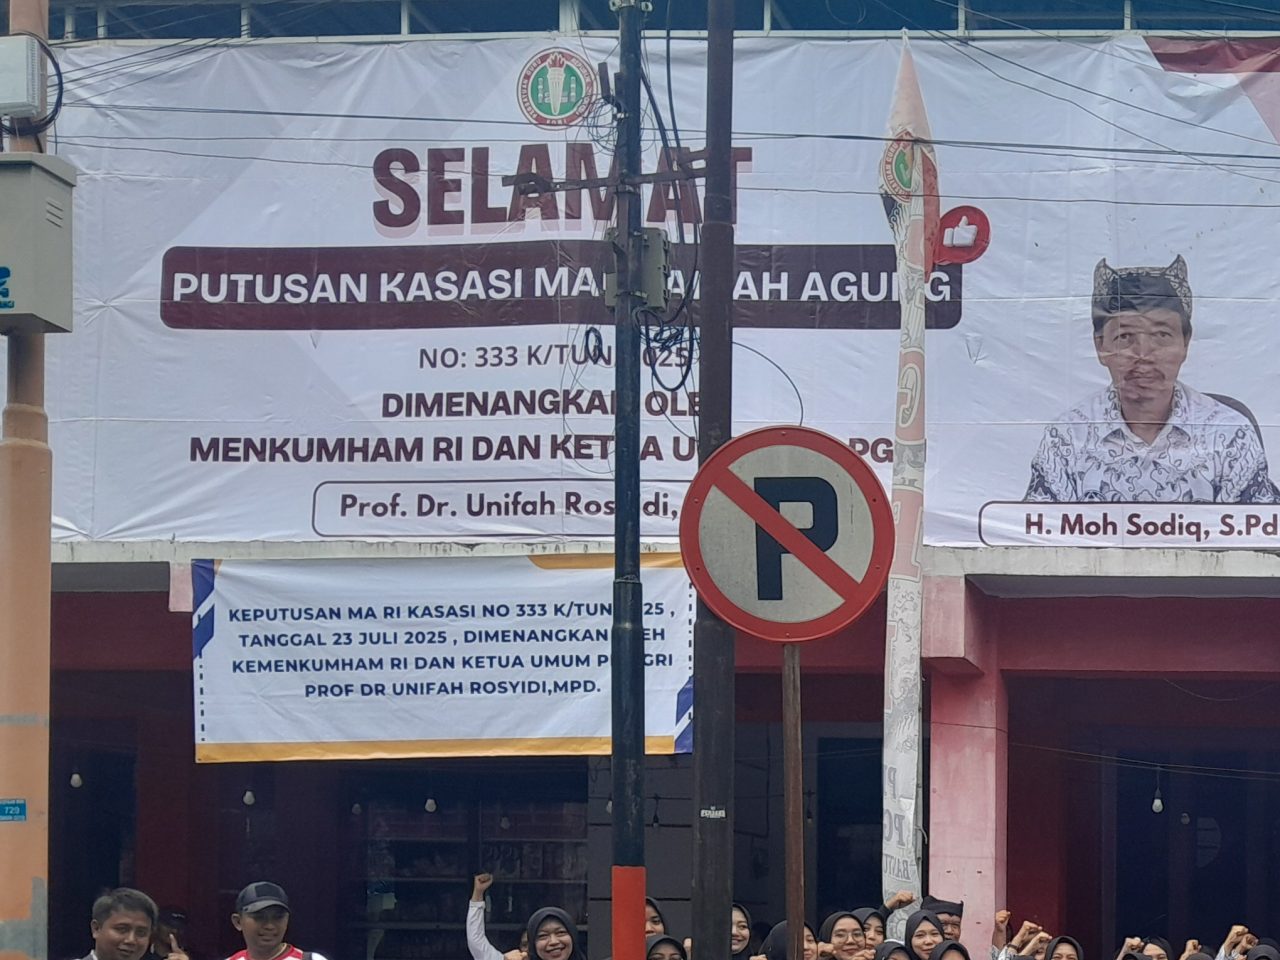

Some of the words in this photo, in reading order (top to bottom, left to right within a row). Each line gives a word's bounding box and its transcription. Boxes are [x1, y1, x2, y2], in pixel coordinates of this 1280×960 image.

[173, 273, 367, 304] PUTUSAN
[379, 268, 522, 302] KASASI
[800, 272, 951, 302] AGUG
[419, 347, 467, 369] NO:
[475, 345, 518, 368] 333
[382, 387, 616, 418] DIMENANGKA
[190, 436, 423, 463] MENKUMHAM
[433, 436, 462, 462] RI
[473, 434, 540, 461] DAN
[551, 434, 663, 461] KETA
[340, 493, 407, 518] Prof.
[417, 494, 456, 517] Dr.
[466, 491, 555, 517] Unifah
[1025, 513, 1052, 535] H.
[1060, 513, 1118, 535] Moh
[1126, 513, 1210, 542] Sodiq,
[1219, 513, 1278, 536] S.Pd
[229, 607, 341, 622] KEPUTUSAN
[348, 607, 377, 620] MA
[383, 606, 401, 619] RI
[408, 605, 475, 618] KASASI
[482, 604, 510, 617] NO
[516, 603, 547, 617] 333
[239, 633, 326, 647] TANGGAL
[332, 632, 352, 645] 23
[359, 631, 398, 645] JULI
[404, 630, 447, 644] 2025
[464, 629, 609, 643] DIMENANGKAN
[232, 657, 383, 673] KEMENKUMHAM
[390, 657, 407, 670] RI
[415, 656, 455, 669] DAN
[462, 655, 524, 668] KETUA
[531, 654, 590, 668] UMUM
[305, 684, 354, 697] PROF
[361, 683, 386, 697] DR
[392, 682, 463, 696] UNIFAH
